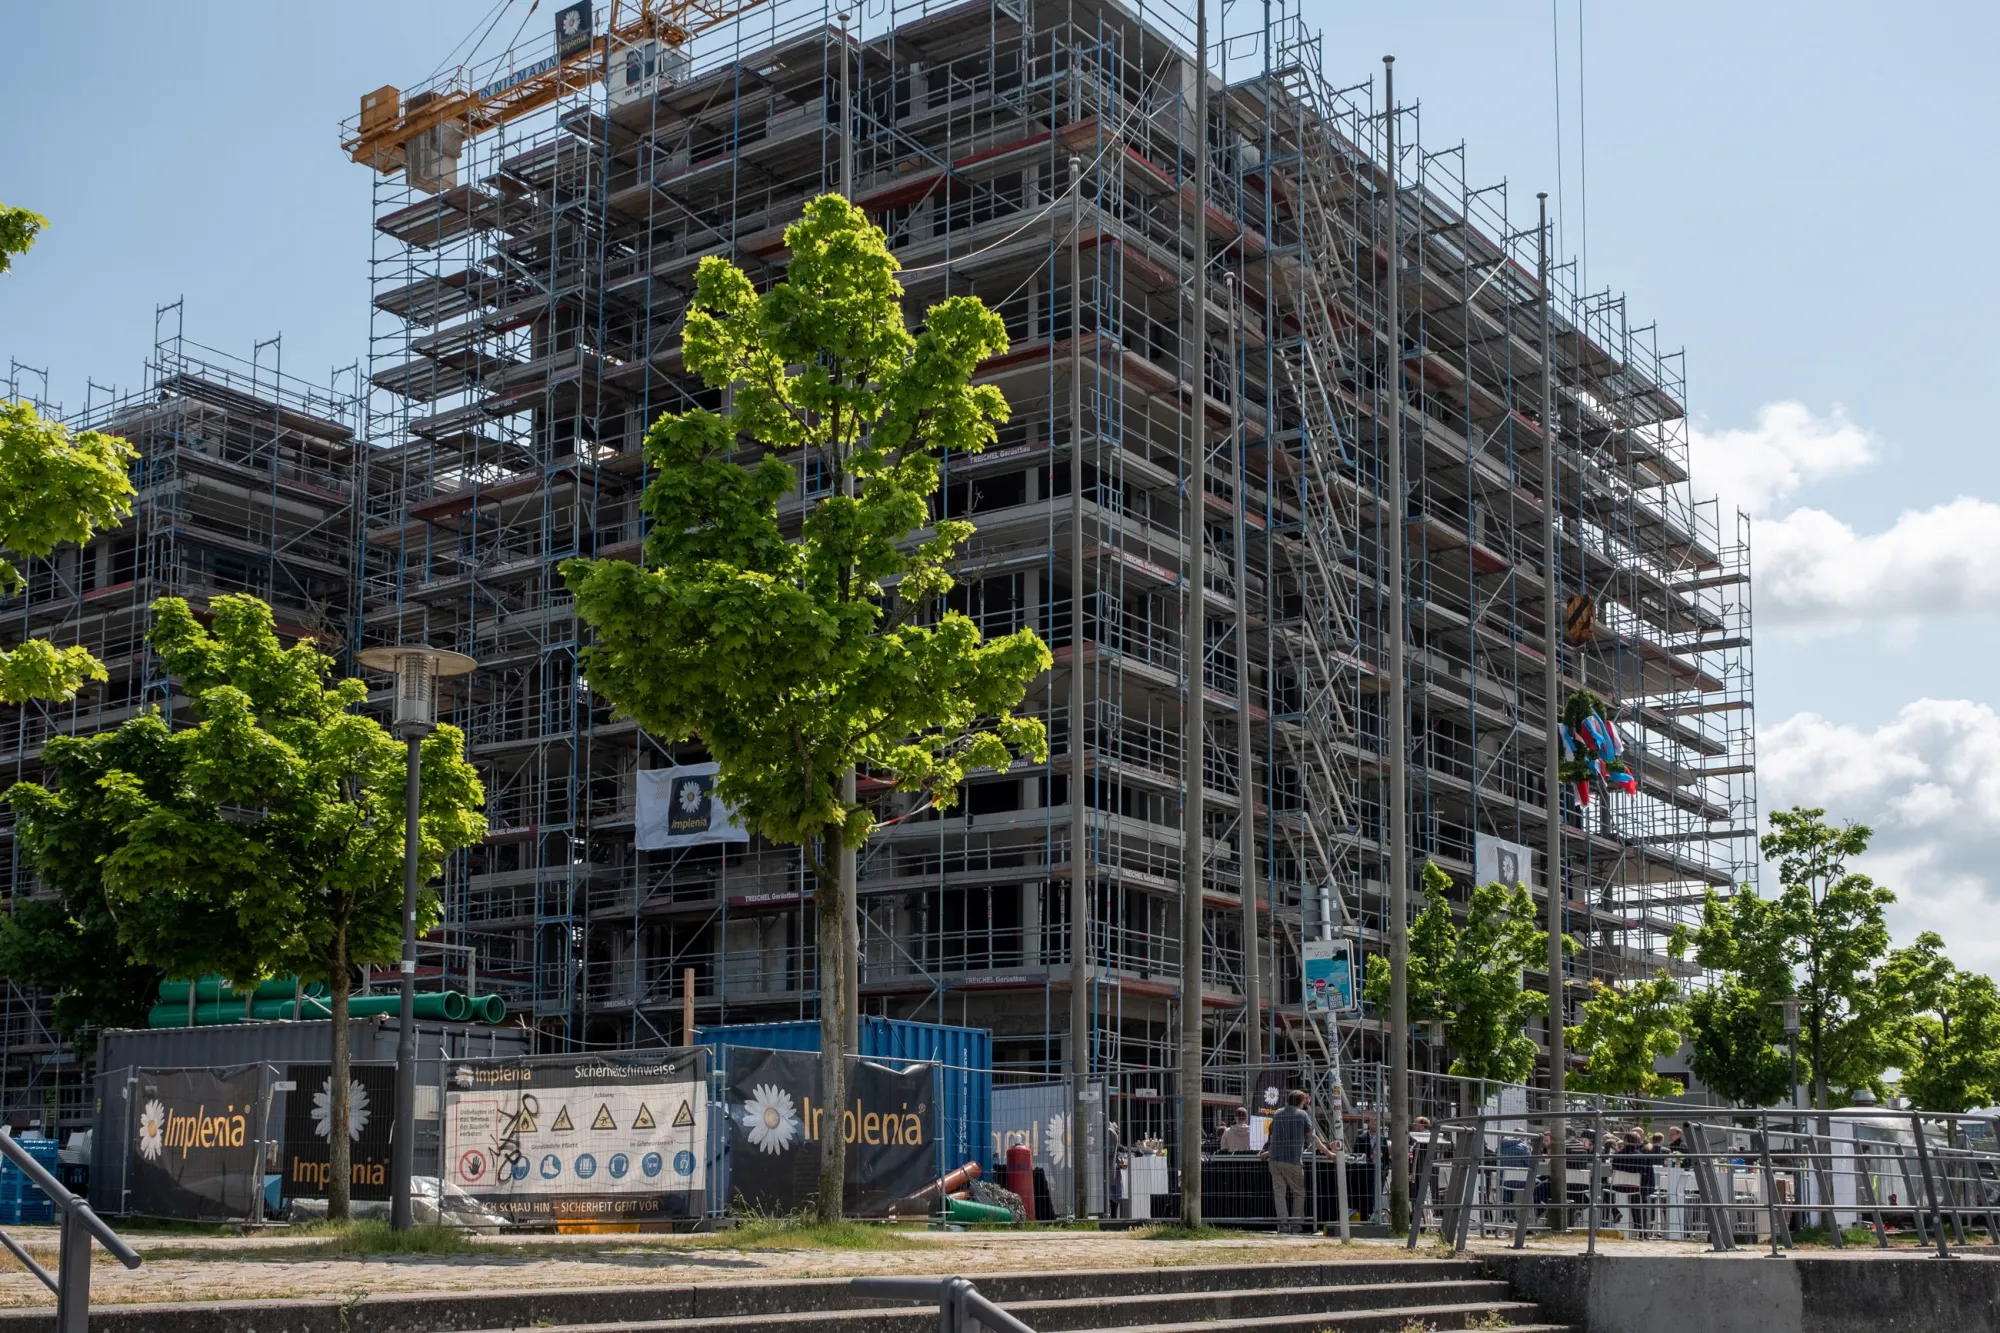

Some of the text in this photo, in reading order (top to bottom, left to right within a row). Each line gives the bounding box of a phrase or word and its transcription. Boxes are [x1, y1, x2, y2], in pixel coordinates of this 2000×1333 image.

[494, 56, 558, 93] NIEMANN
[969, 445, 1031, 464] TREICHEL Gerüstbau
[671, 816, 708, 831] Implenia
[745, 892, 799, 902] TREICHEL Gerüstbau
[964, 975, 1027, 984] TREICHEL Gerüstbau
[604, 1000, 627, 1008] TREICHEL
[475, 1064, 531, 1086] Implenia
[292, 1155, 385, 1191] Impnia
[499, 1202, 531, 1213] SCHAU
[533, 1202, 550, 1213] HIN
[561, 1201, 613, 1213] SICHERHEIT
[614, 1201, 637, 1212] GEHT
[640, 1200, 659, 1211] VOR
